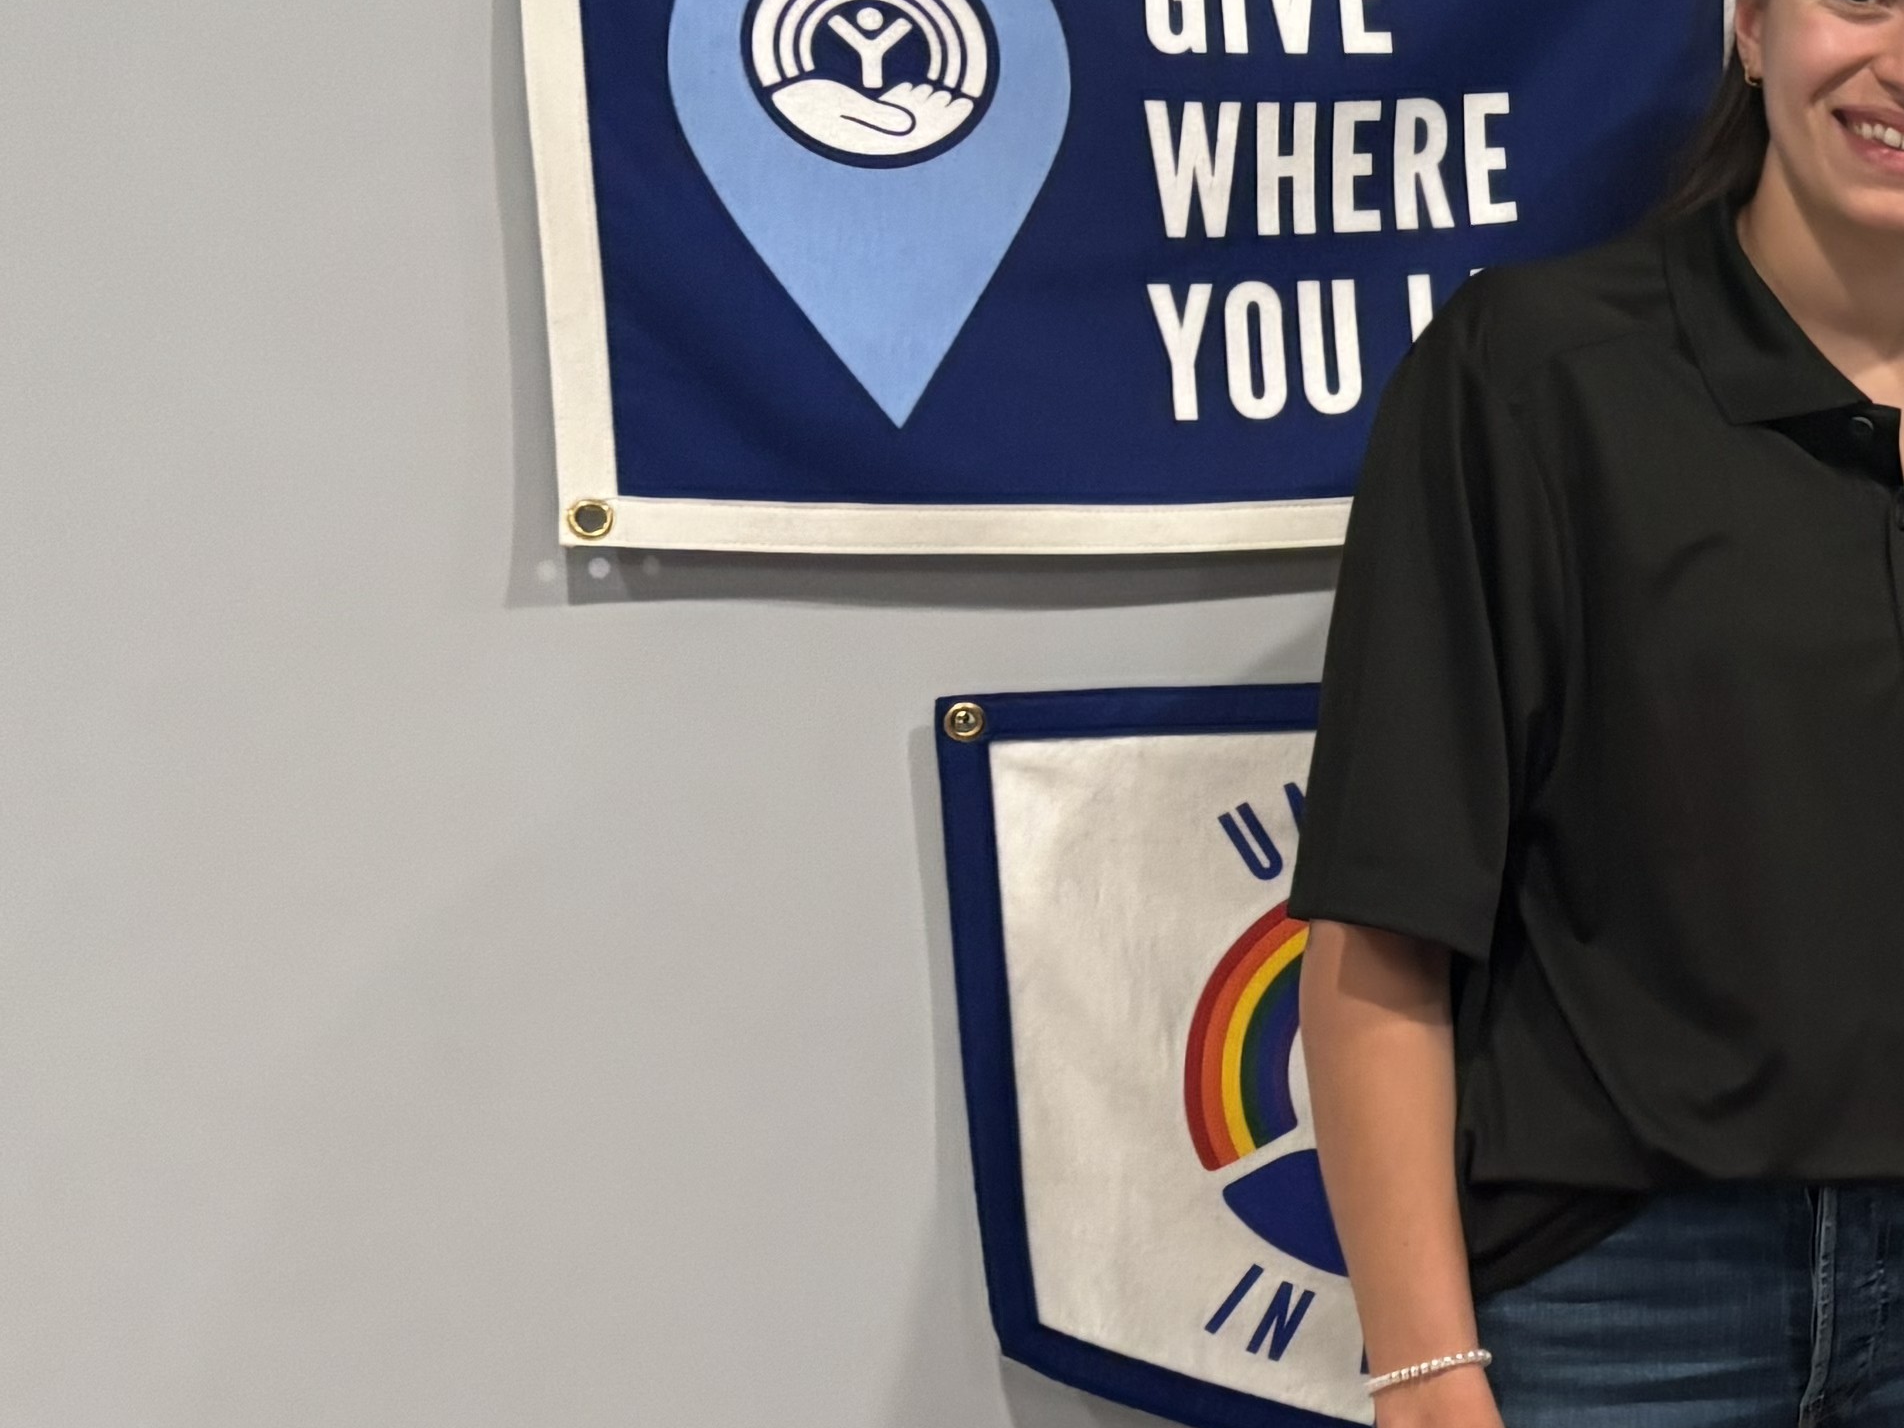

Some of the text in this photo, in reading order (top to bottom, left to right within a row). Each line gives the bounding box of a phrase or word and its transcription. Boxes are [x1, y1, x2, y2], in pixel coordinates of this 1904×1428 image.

[1144, 92, 1518, 239] WHERE
[1147, 279, 1363, 421] YOU
[1205, 1263, 1316, 1362] IN
